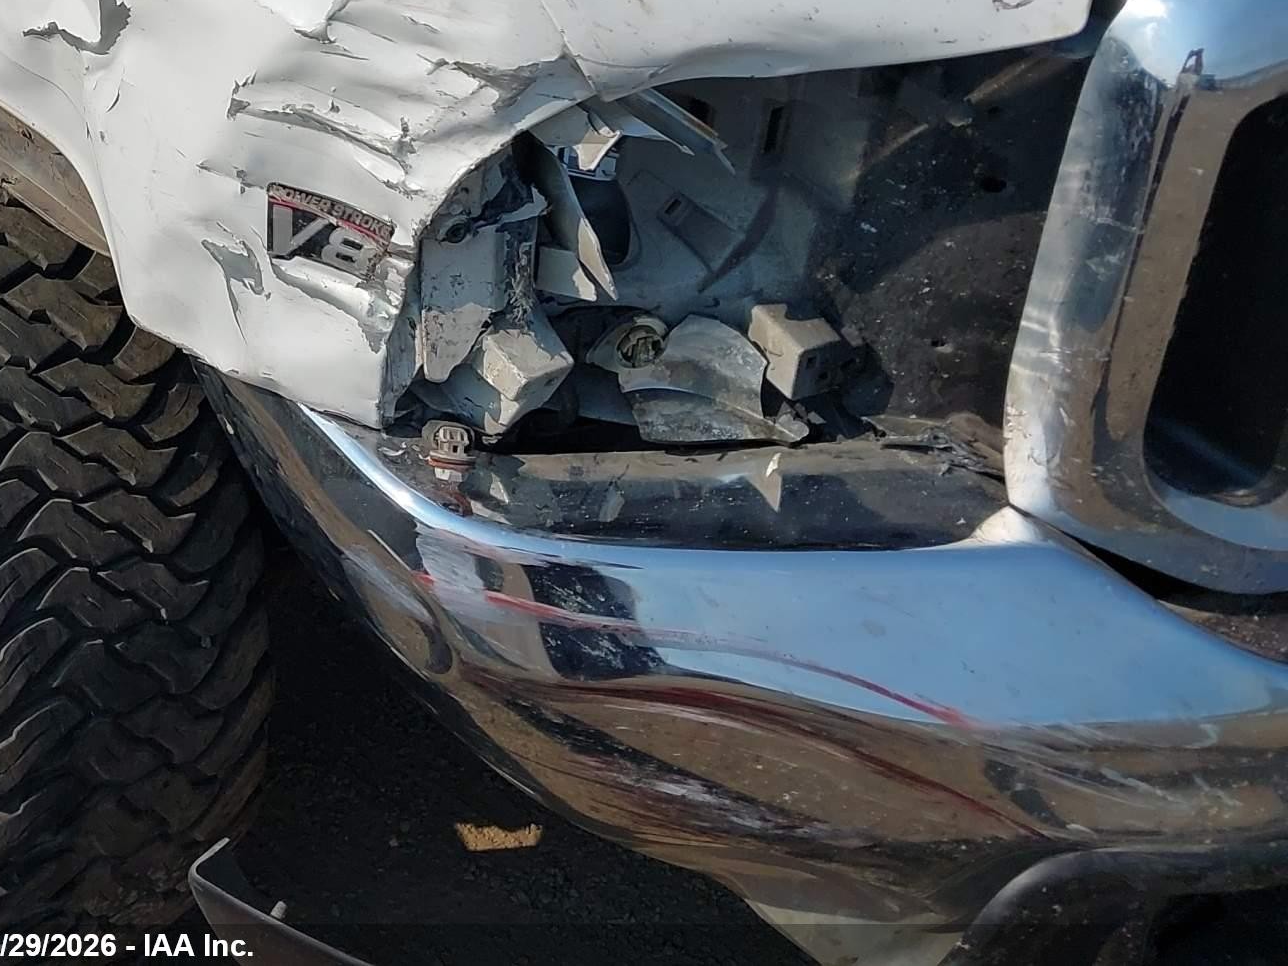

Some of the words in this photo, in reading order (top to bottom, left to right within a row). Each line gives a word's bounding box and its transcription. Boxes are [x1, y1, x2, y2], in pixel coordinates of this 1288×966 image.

[268, 184, 332, 214] POWER
[332, 202, 393, 241] STROKE
[271, 203, 378, 279] V8
